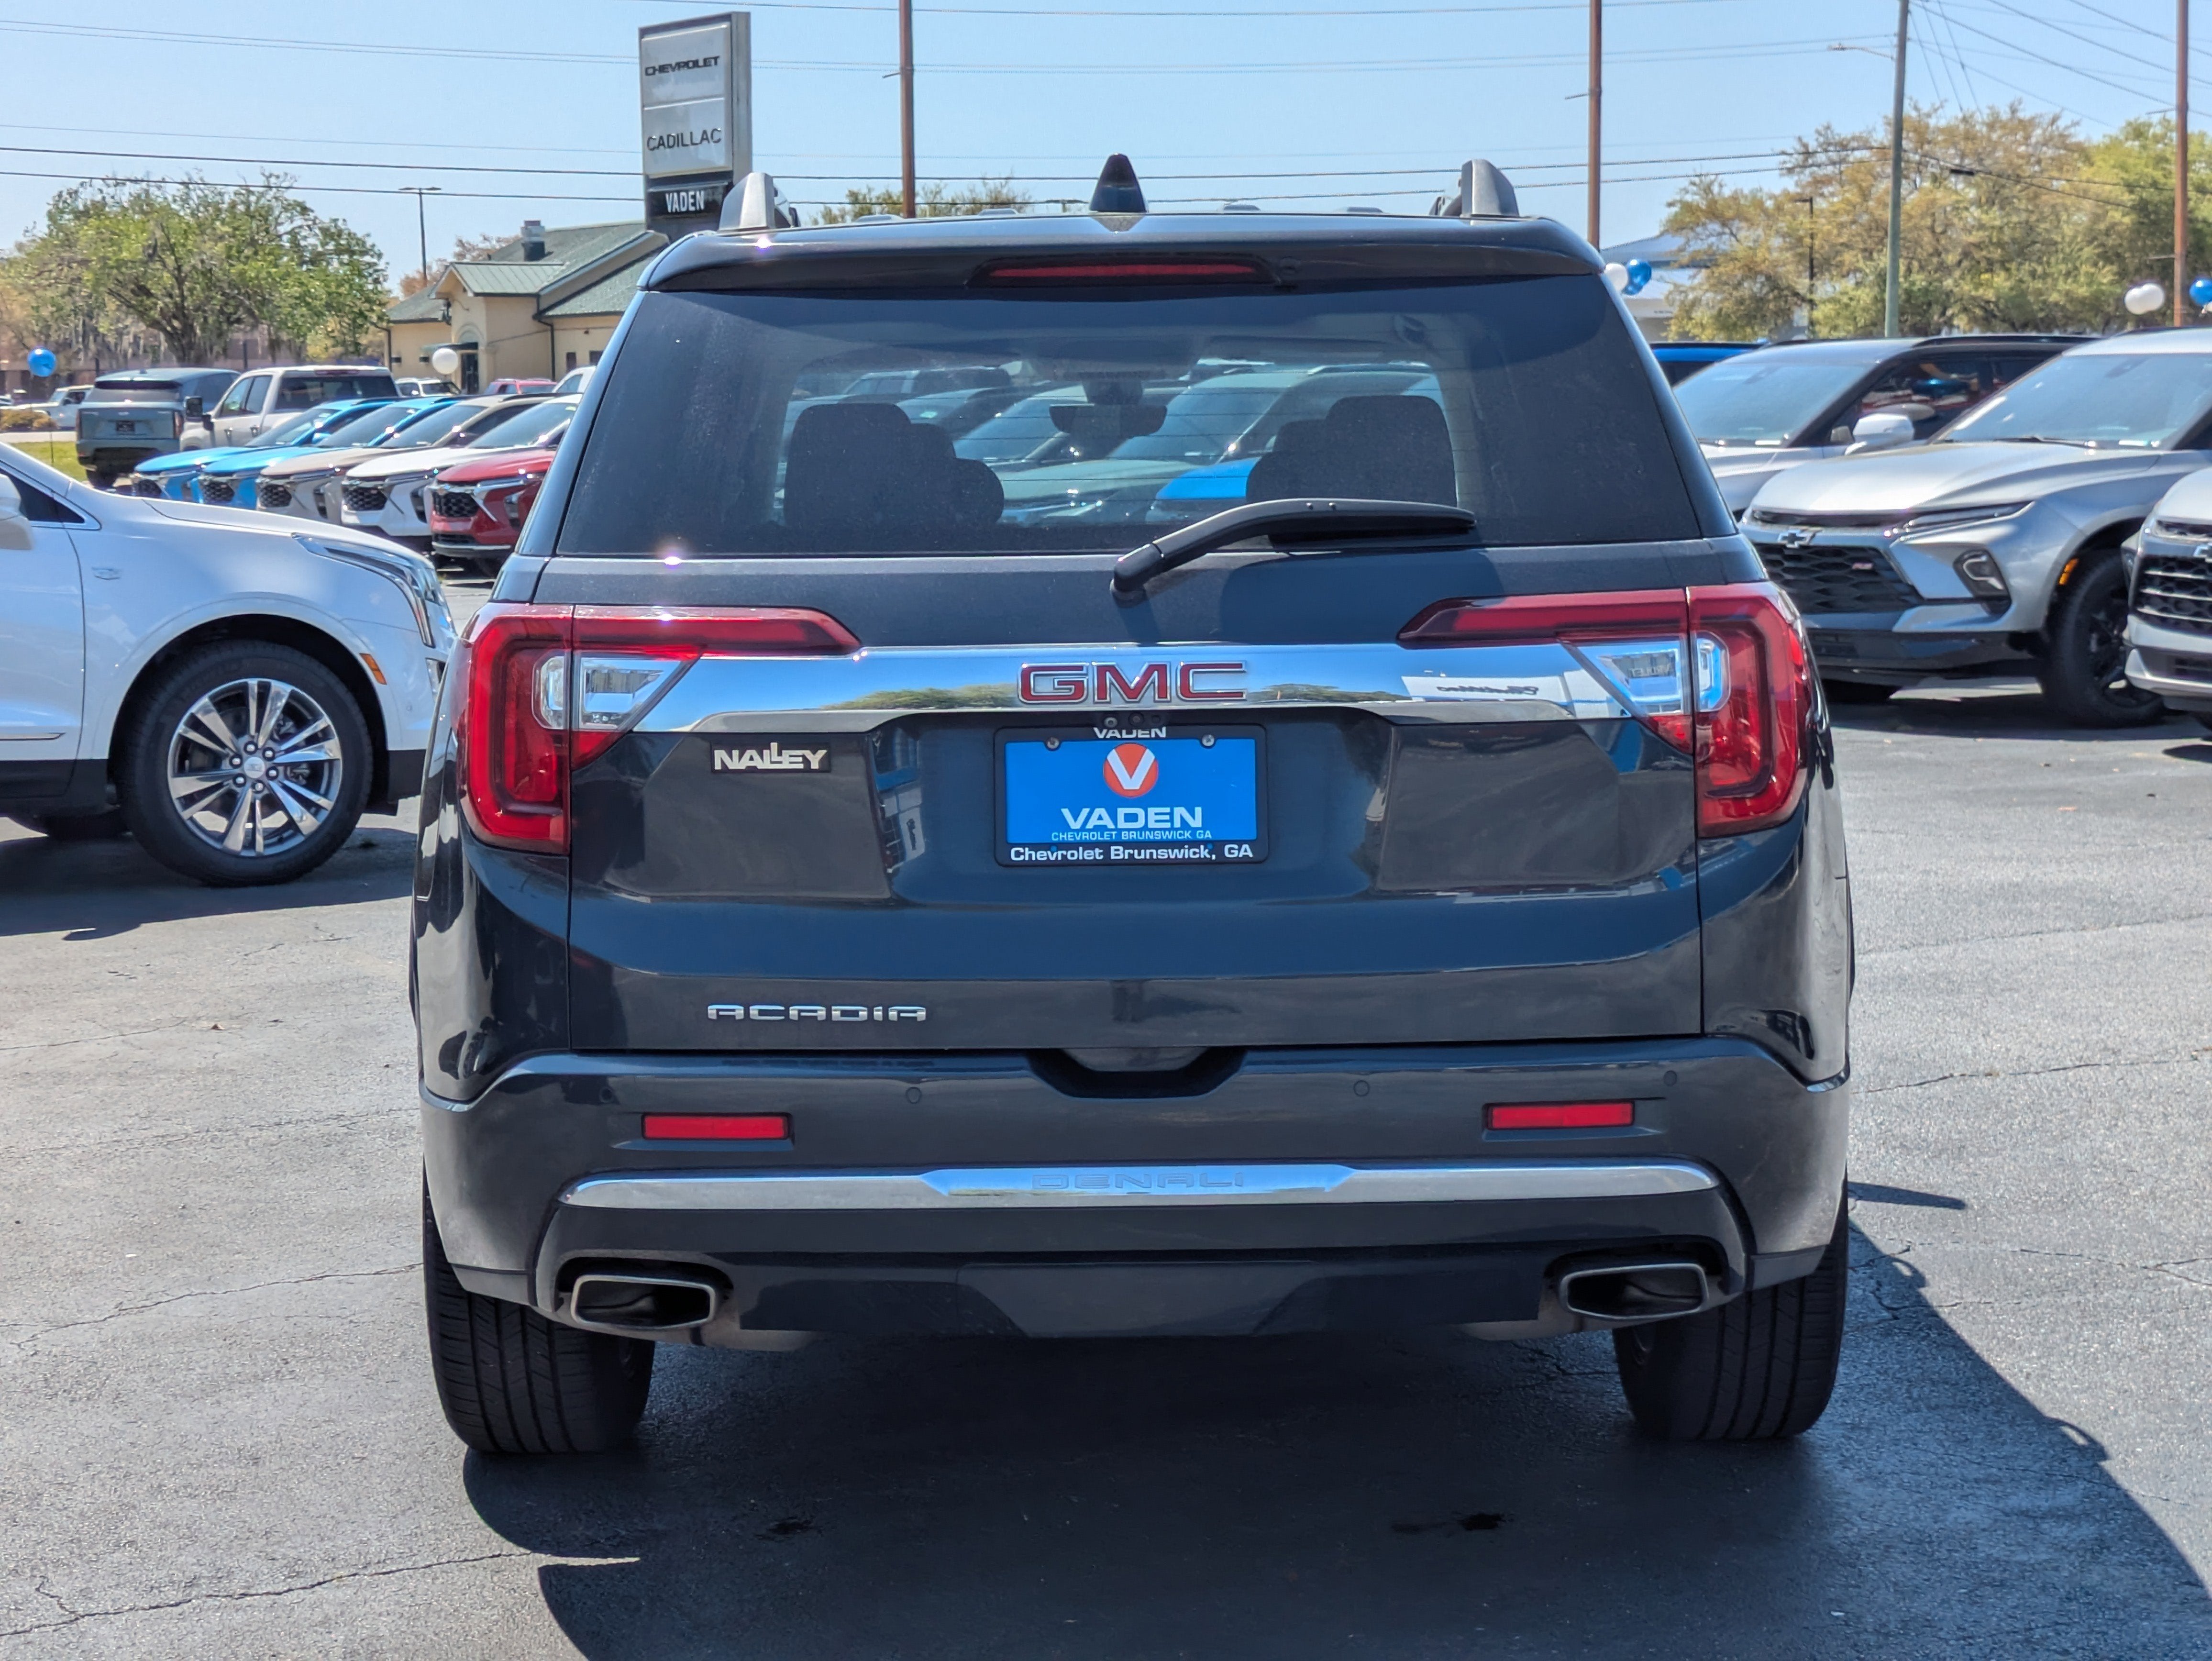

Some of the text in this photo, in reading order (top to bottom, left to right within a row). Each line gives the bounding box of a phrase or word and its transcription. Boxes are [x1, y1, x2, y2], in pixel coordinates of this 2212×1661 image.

[645, 55, 720, 76] CHEVROLET
[647, 128, 721, 151] CADILLAC
[665, 190, 704, 213] VADEN
[1018, 661, 1247, 704] GMC
[714, 742, 827, 770] NALLEY
[1061, 807, 1202, 829] VADEN
[1052, 830, 1212, 841] CHEVROLET BRUNSWICK GA
[1010, 844, 1253, 861] Chevrolet Brunswick, GA
[708, 1005, 926, 1021] ACADIA
[1032, 1173, 1243, 1190] DENALI
